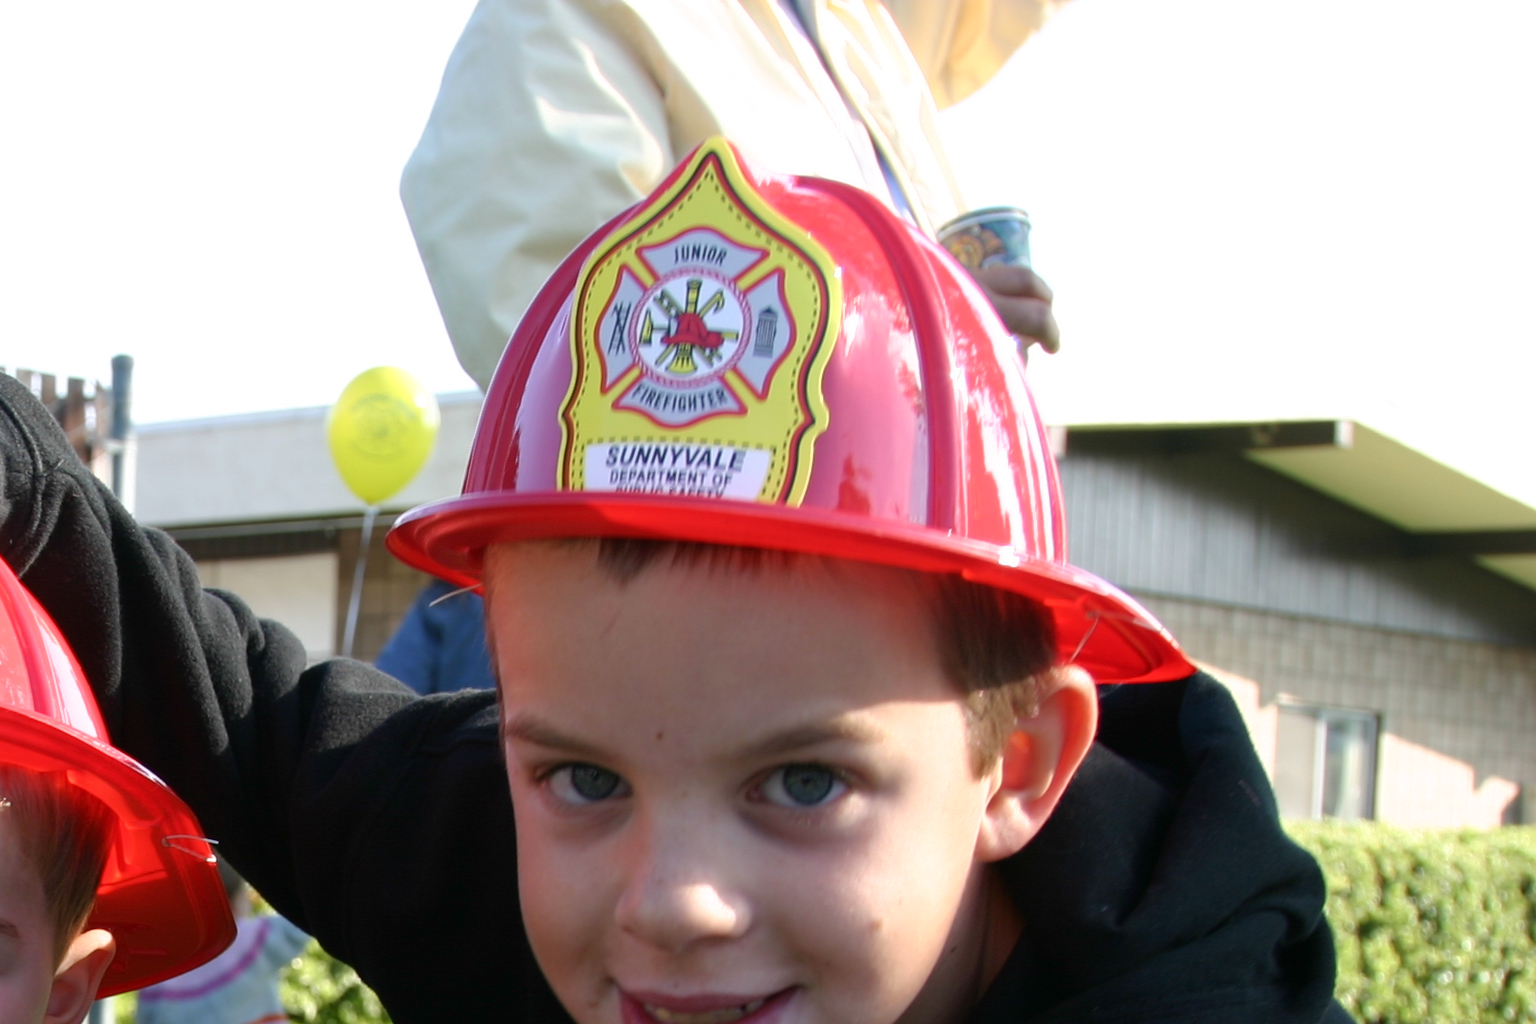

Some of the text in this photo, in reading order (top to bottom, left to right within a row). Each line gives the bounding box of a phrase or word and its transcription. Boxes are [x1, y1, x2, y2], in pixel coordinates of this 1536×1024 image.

[674, 243, 727, 267] JUNIOR
[631, 383, 728, 413] FIREFIGHTER
[605, 444, 747, 472] SUNNYVALE
[609, 467, 733, 488] DEPARTMENT OF
